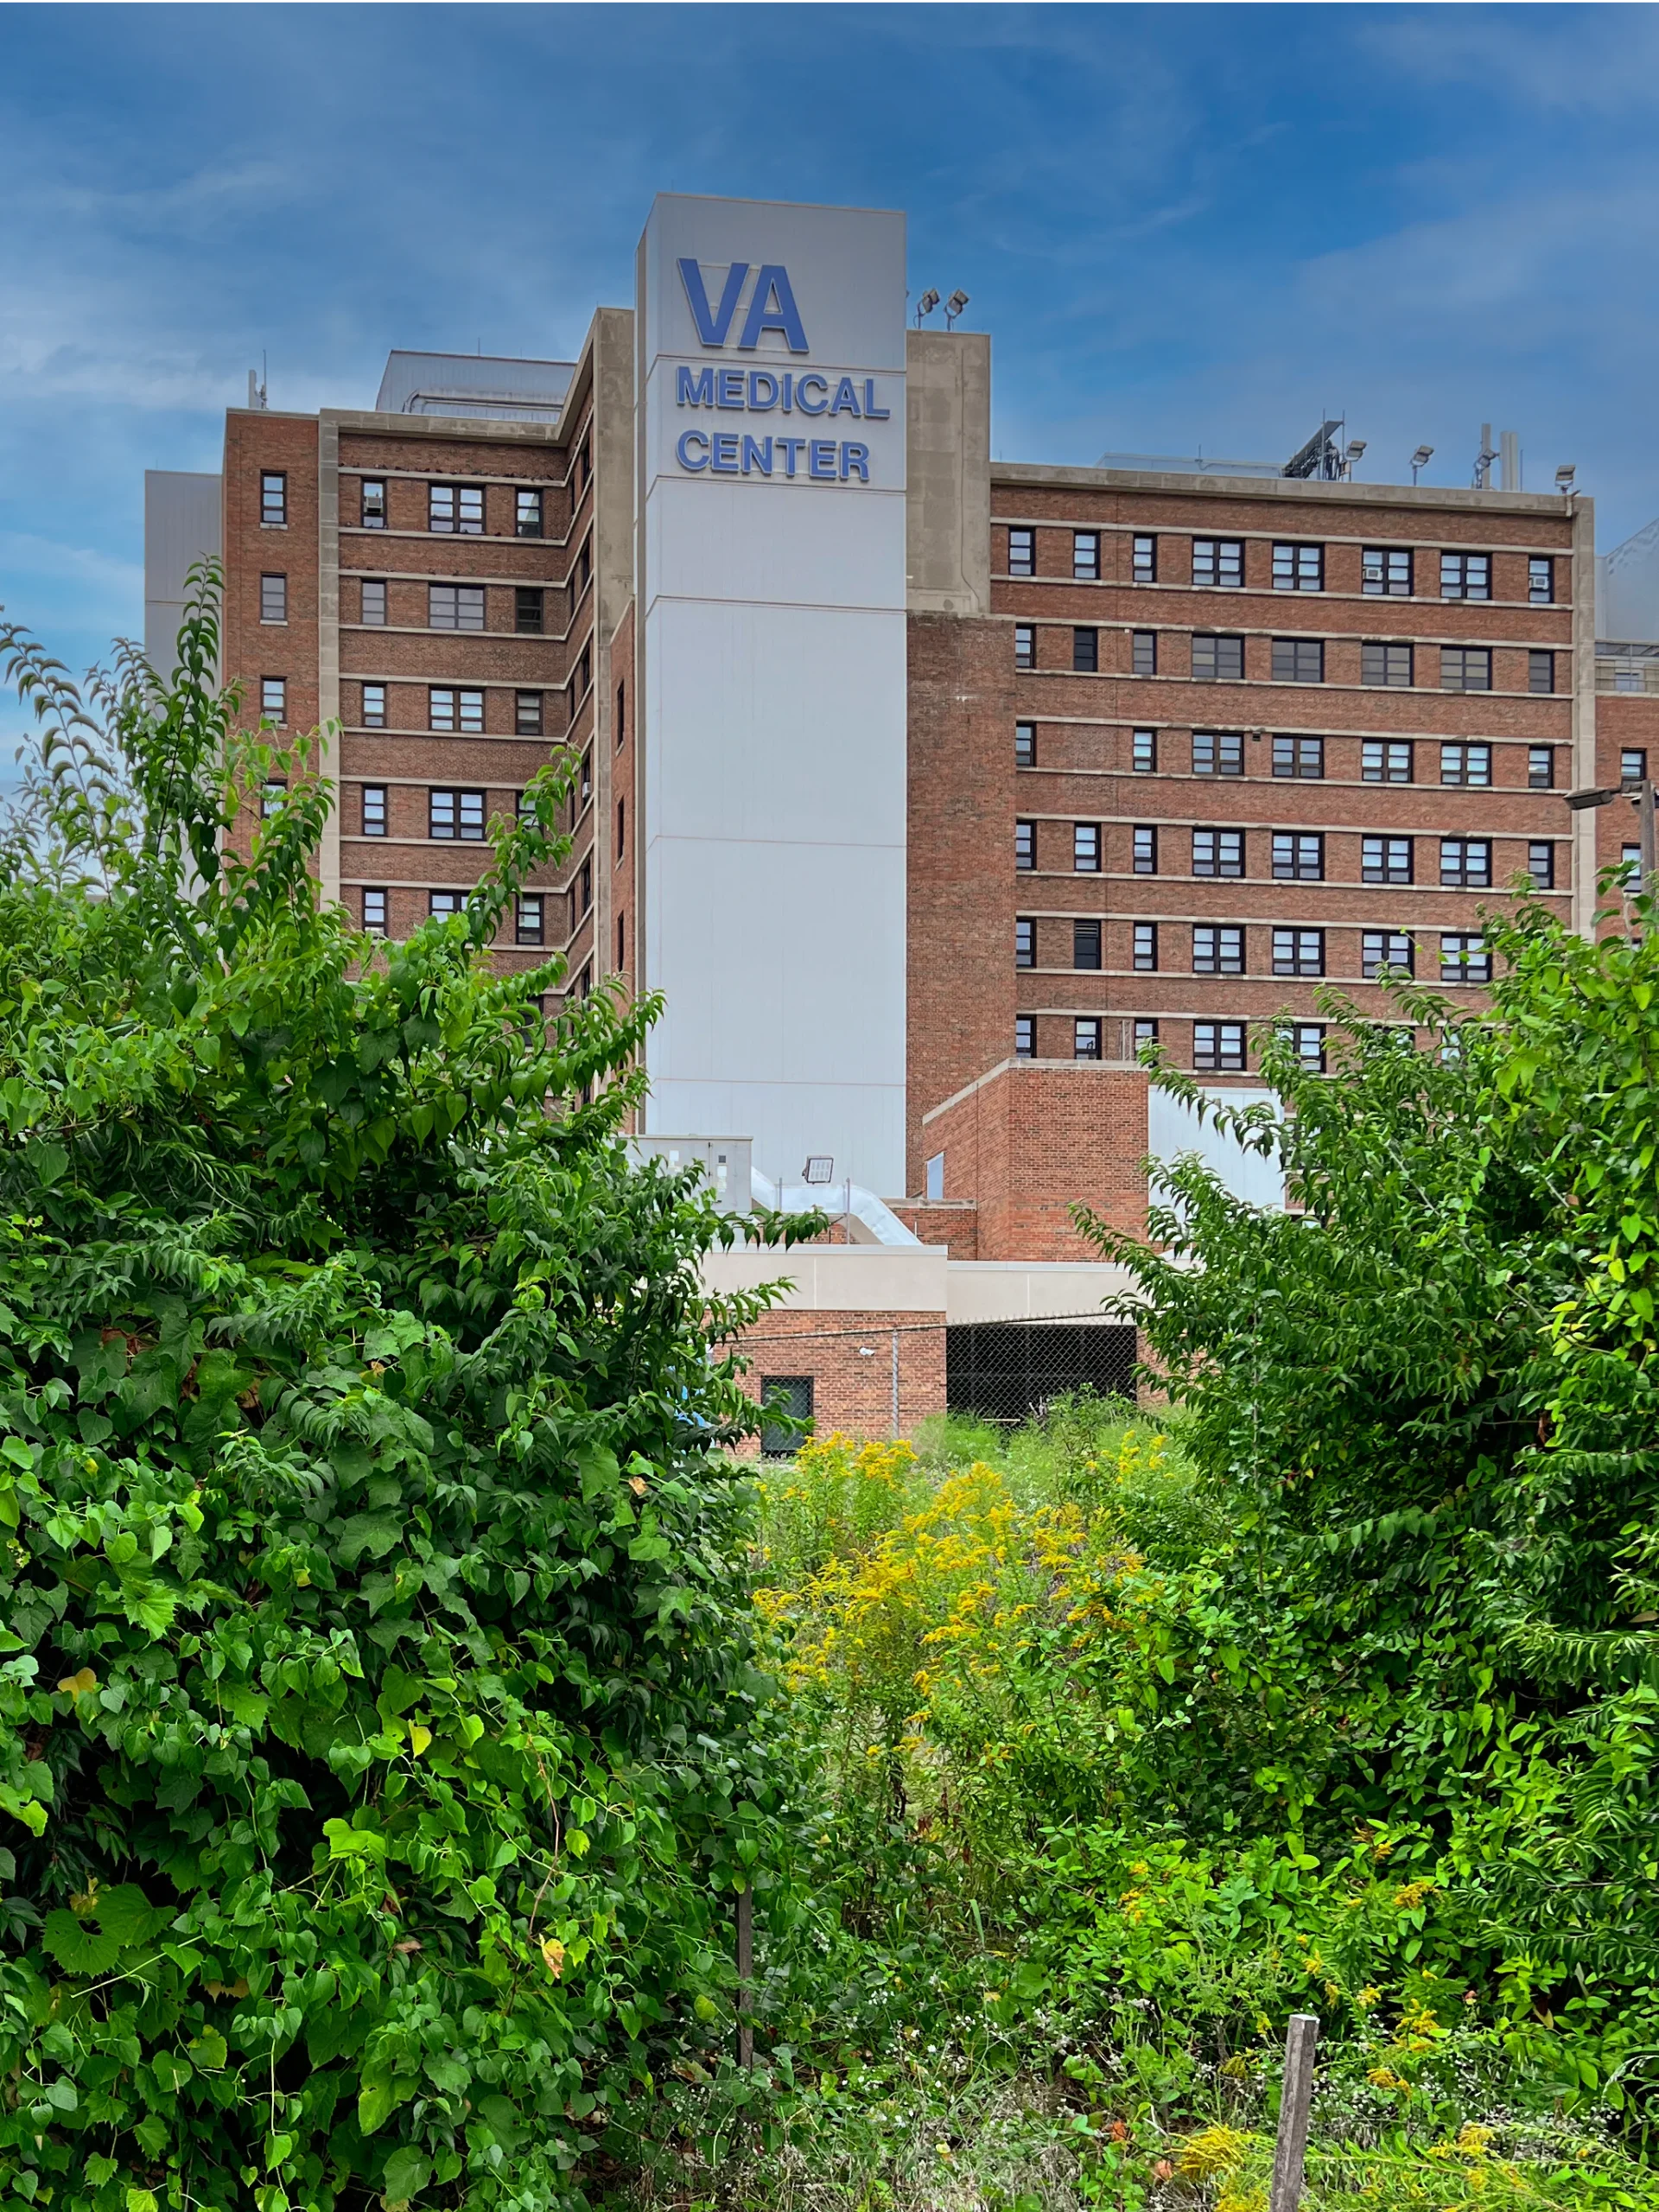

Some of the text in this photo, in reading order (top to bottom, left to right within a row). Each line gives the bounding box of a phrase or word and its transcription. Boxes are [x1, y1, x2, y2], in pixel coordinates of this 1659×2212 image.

[677, 258, 810, 353] VA
[677, 366, 891, 418] MEDICAL
[676, 429, 870, 481] CENTER
